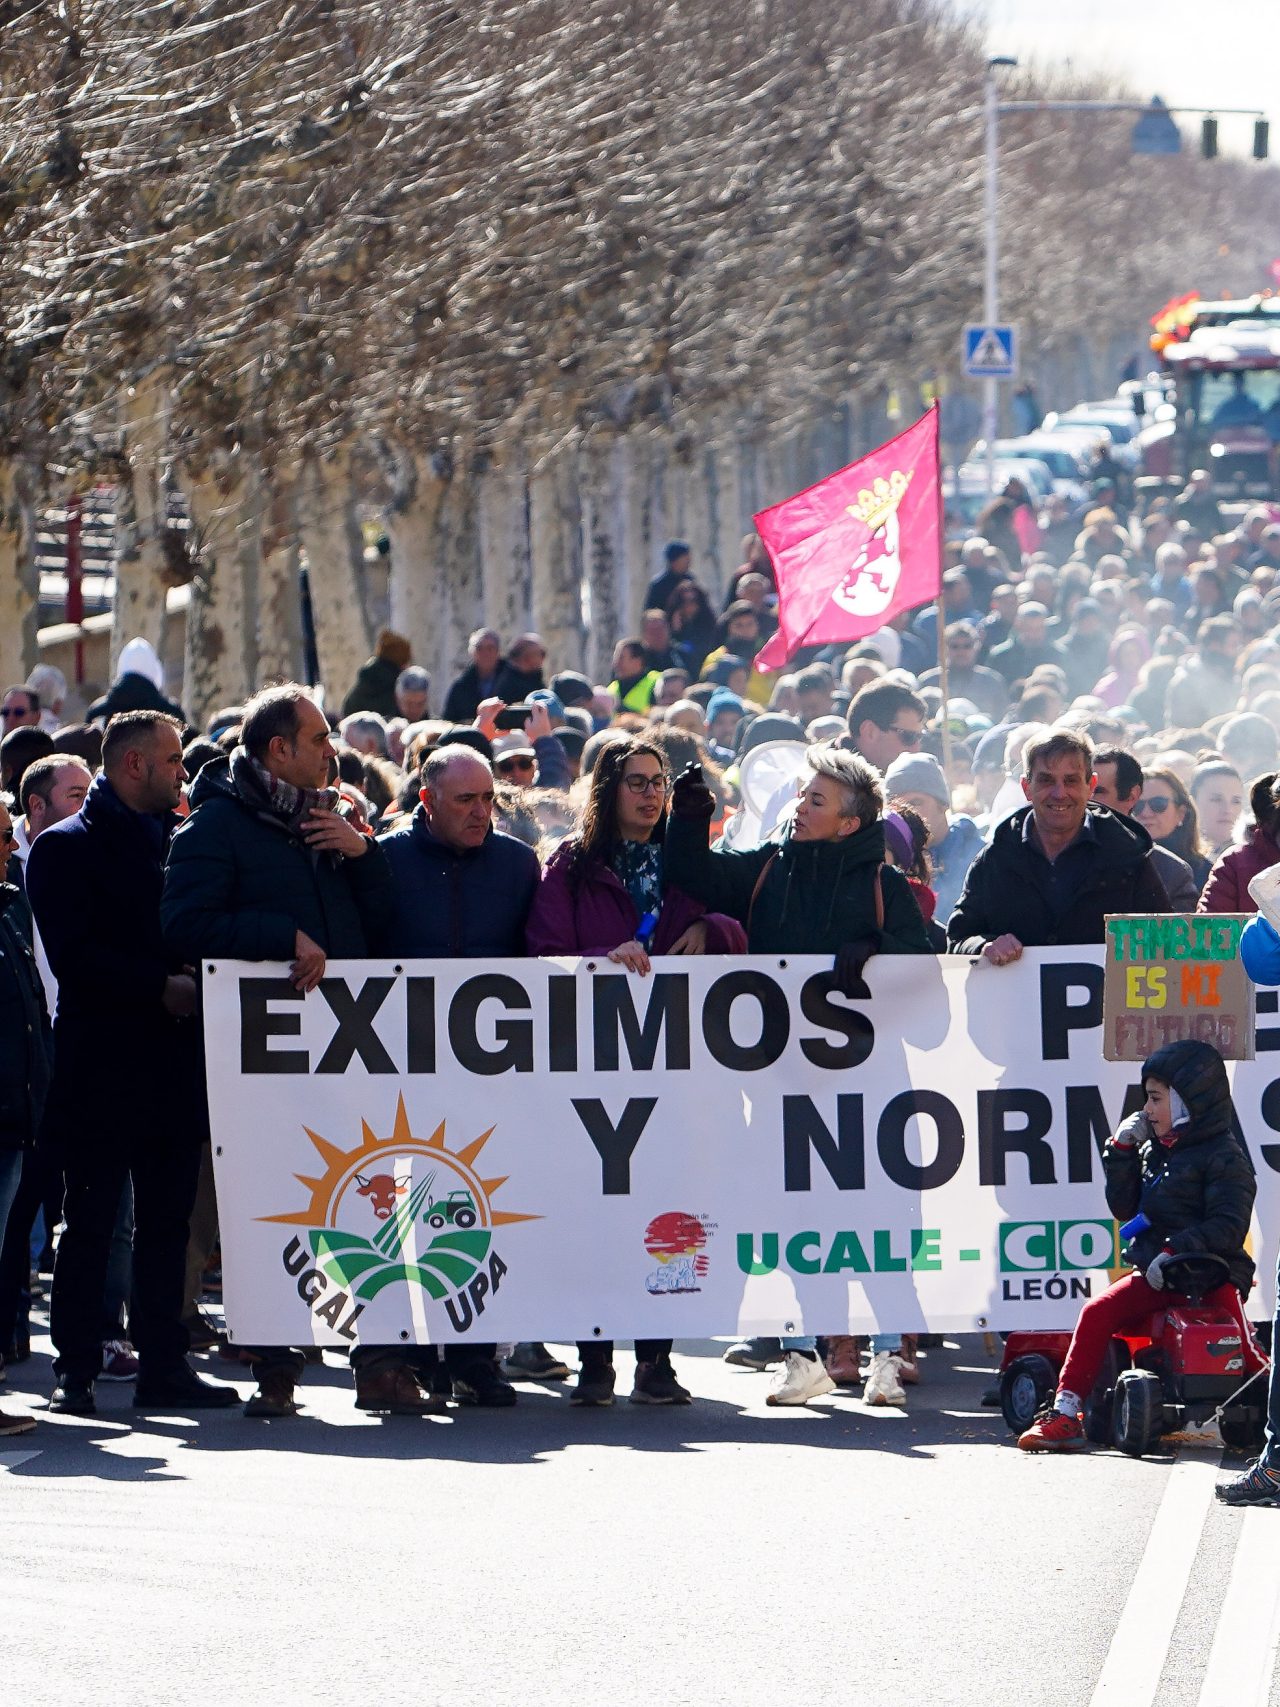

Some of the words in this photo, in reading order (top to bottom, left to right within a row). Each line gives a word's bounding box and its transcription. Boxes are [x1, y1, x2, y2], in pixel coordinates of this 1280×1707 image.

[239, 969, 875, 1075] EXIGIMOS
[1126, 965, 1168, 1009] ES
[1181, 963, 1223, 1008] MI
[570, 1097, 659, 1195] Y
[282, 1233, 366, 1341] UGAL
[444, 1250, 508, 1333] UPA
[736, 1229, 942, 1275] UCALE
[1002, 1273, 1092, 1301] LEÓN
